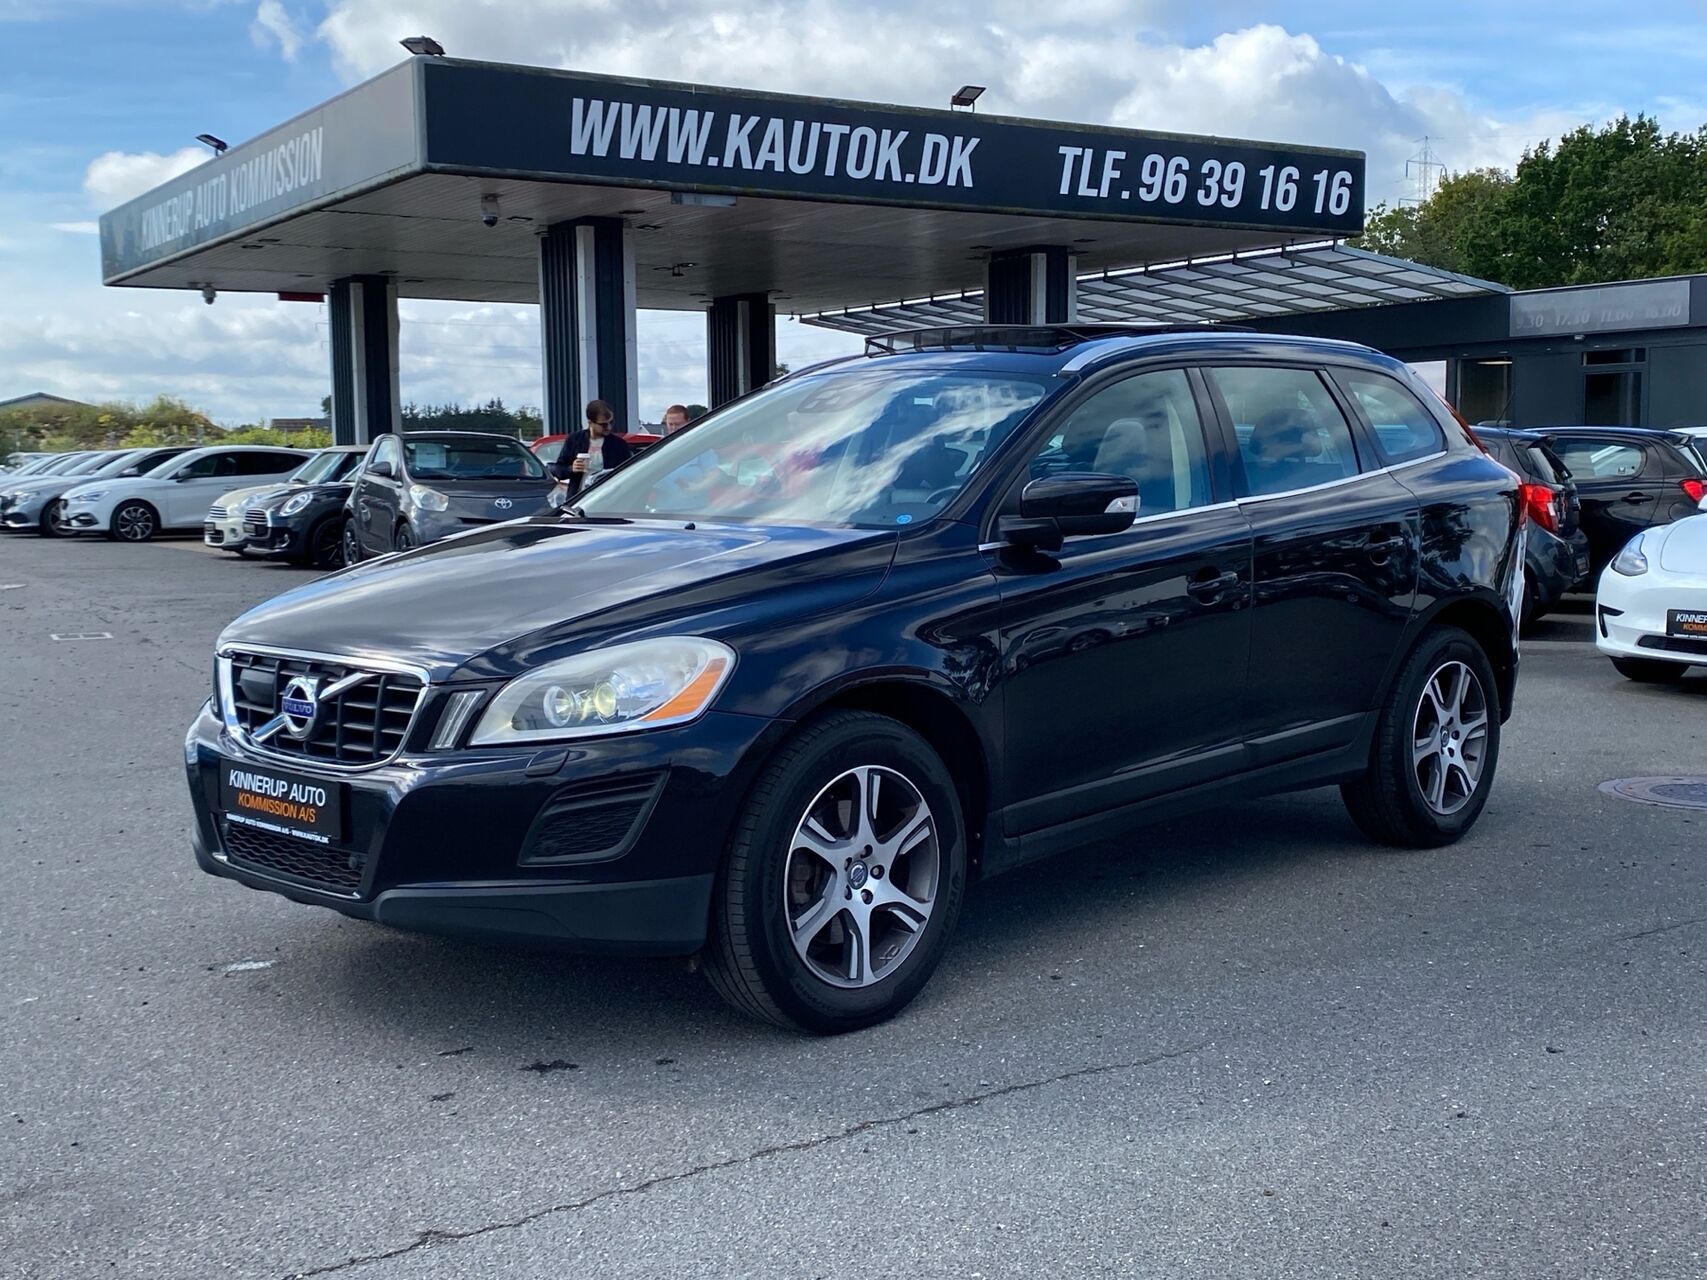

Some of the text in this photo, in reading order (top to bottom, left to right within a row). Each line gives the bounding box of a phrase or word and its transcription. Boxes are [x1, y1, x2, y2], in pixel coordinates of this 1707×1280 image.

[570, 97, 981, 188] WWW.KAUTOK.DK
[142, 126, 323, 251] KINNERUP AUTO KOMMISSION
[1058, 146, 1352, 216] TLF. 96 39 16 16
[283, 701, 312, 714] VOLVO
[229, 769, 326, 807] KINNERUP AUTO
[238, 792, 298, 818] KOMMISSION
[298, 807, 316, 823] A/S
